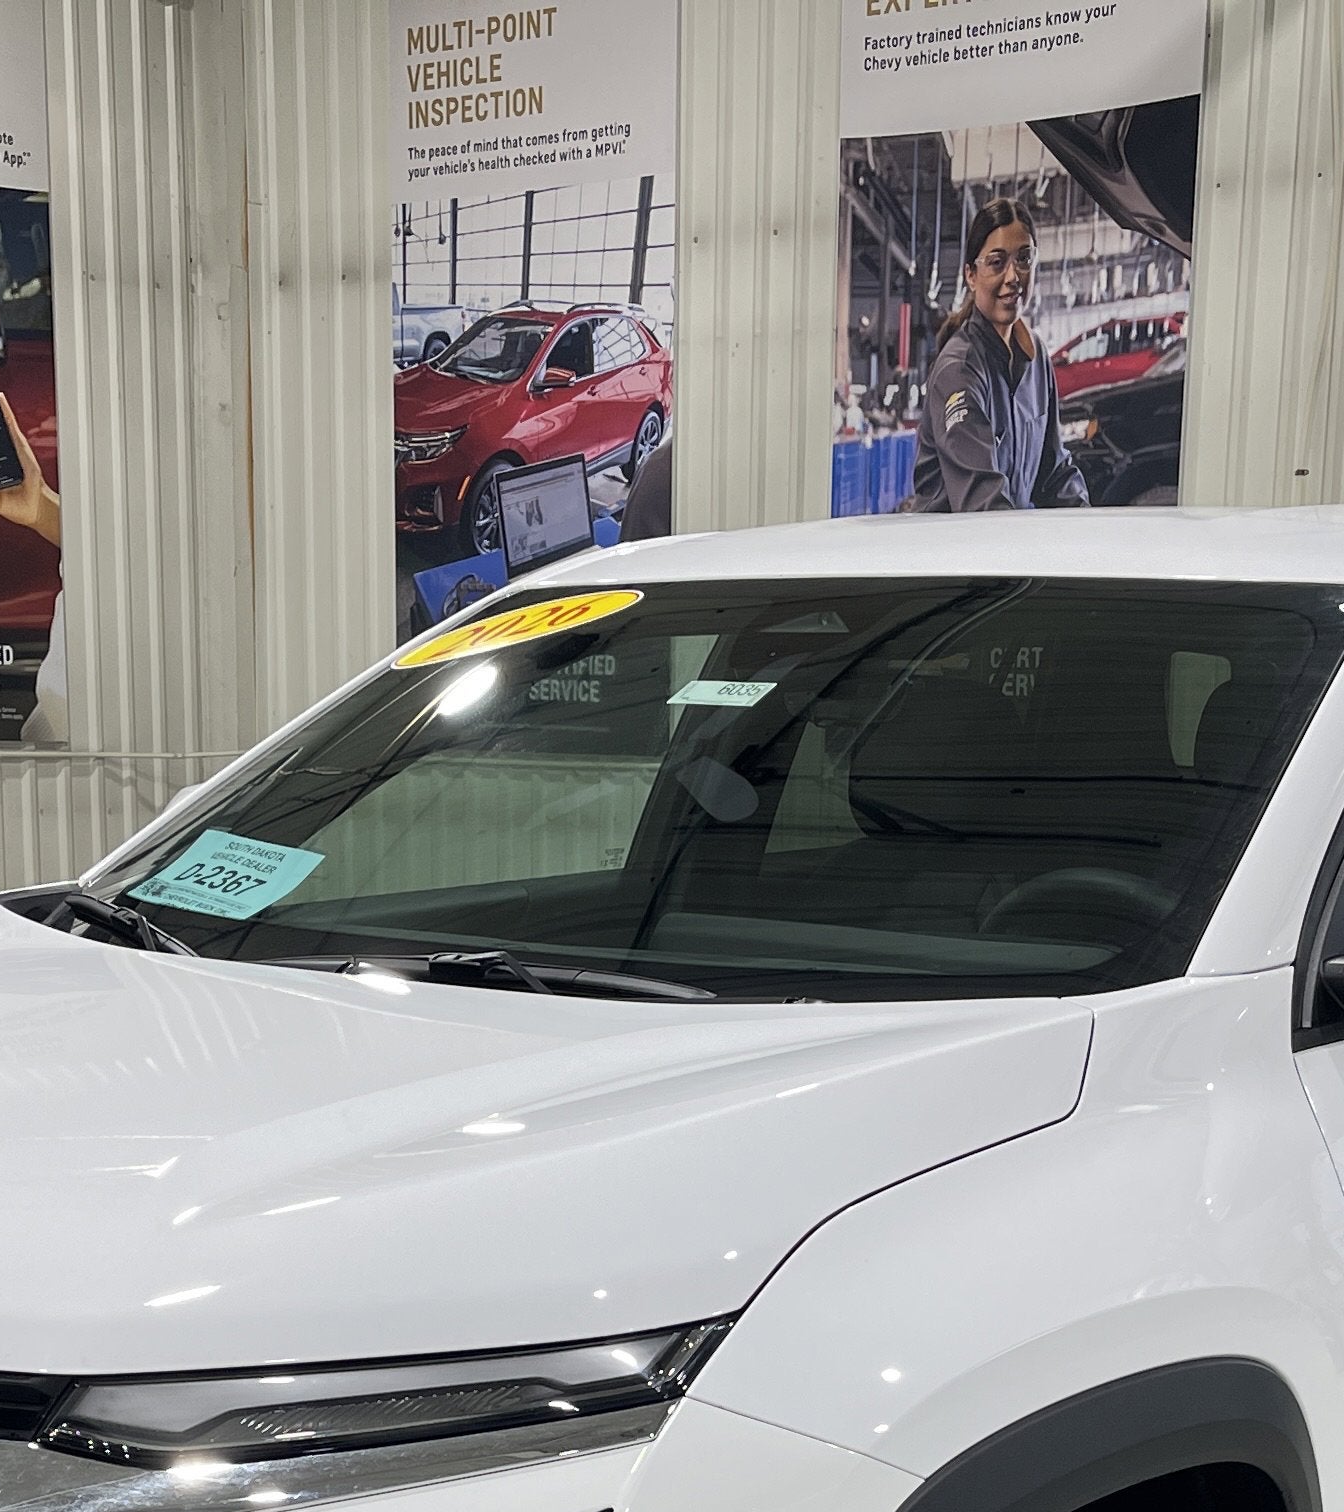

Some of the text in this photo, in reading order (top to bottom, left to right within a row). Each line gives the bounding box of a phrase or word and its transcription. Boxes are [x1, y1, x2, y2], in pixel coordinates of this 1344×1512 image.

[407, 7, 557, 55] MULTI-POINT
[864, 3, 1116, 51] Factory trained technicians know your
[864, 31, 1084, 72] Chevy vehicle better than anyone.
[407, 54, 502, 92] VEHICLE
[408, 86, 543, 129] INSPECTION
[408, 123, 631, 162] The peace of mind that comes from getting
[408, 166, 430, 182] your
[433, 158, 475, 176] vehicle's
[478, 155, 510, 171] health
[513, 151, 556, 167] checked
[559, 146, 582, 162] with
[586, 148, 592, 158] a
[990, 646, 1044, 668] CRT
[528, 679, 600, 703] SERVICE
[241, 858, 277, 875] DEALER
[251, 847, 286, 863] DAKOTA
[173, 862, 267, 896] D-2367
